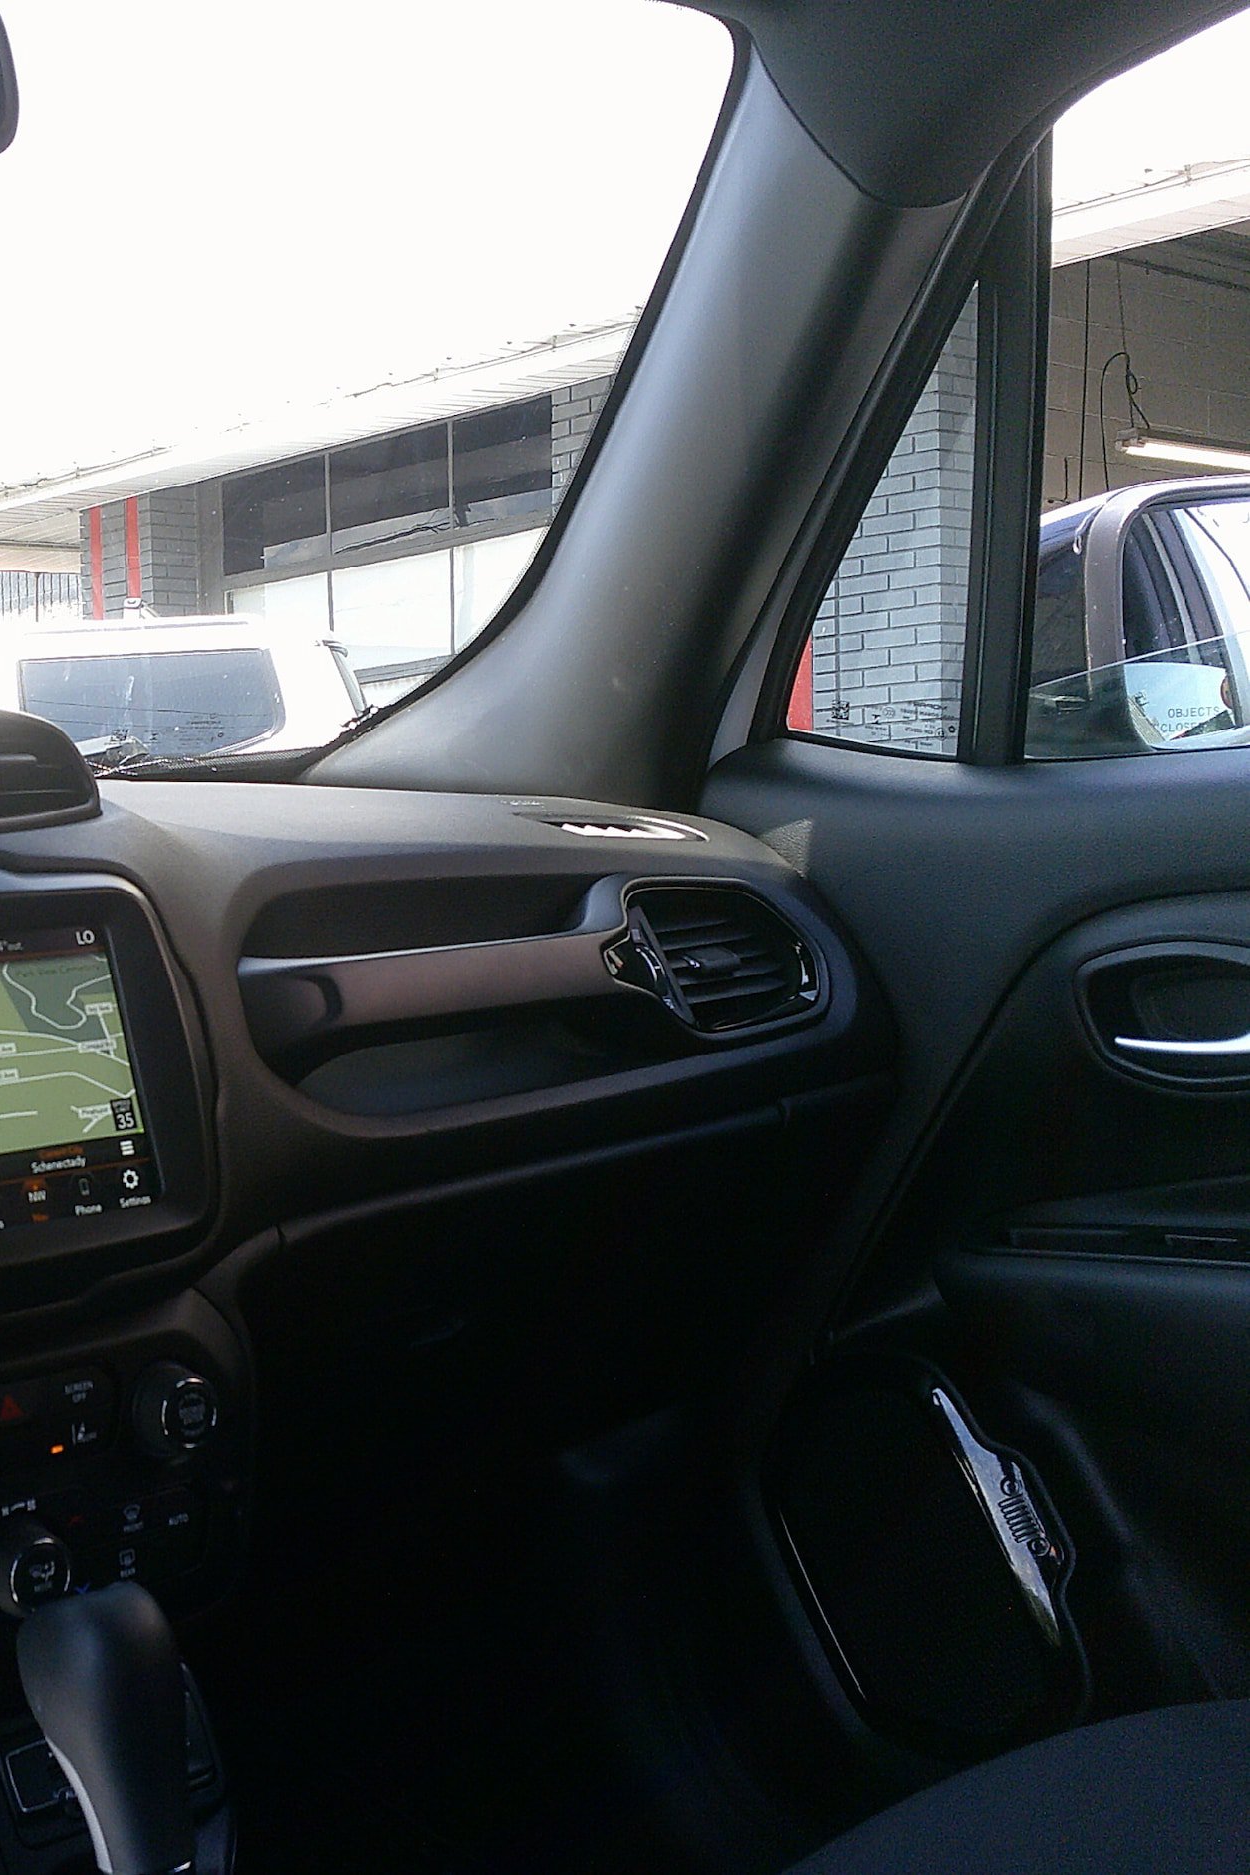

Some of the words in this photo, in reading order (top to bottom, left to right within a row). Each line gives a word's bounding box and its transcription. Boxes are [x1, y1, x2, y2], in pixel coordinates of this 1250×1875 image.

[1167, 706, 1221, 719] OBJECTS
[75, 930, 96, 945] LO
[116, 1113, 135, 1130] 35
[31, 1156, 87, 1173] Schenectady
[119, 1195, 152, 1209] Settings
[74, 1203, 103, 1216] Phone
